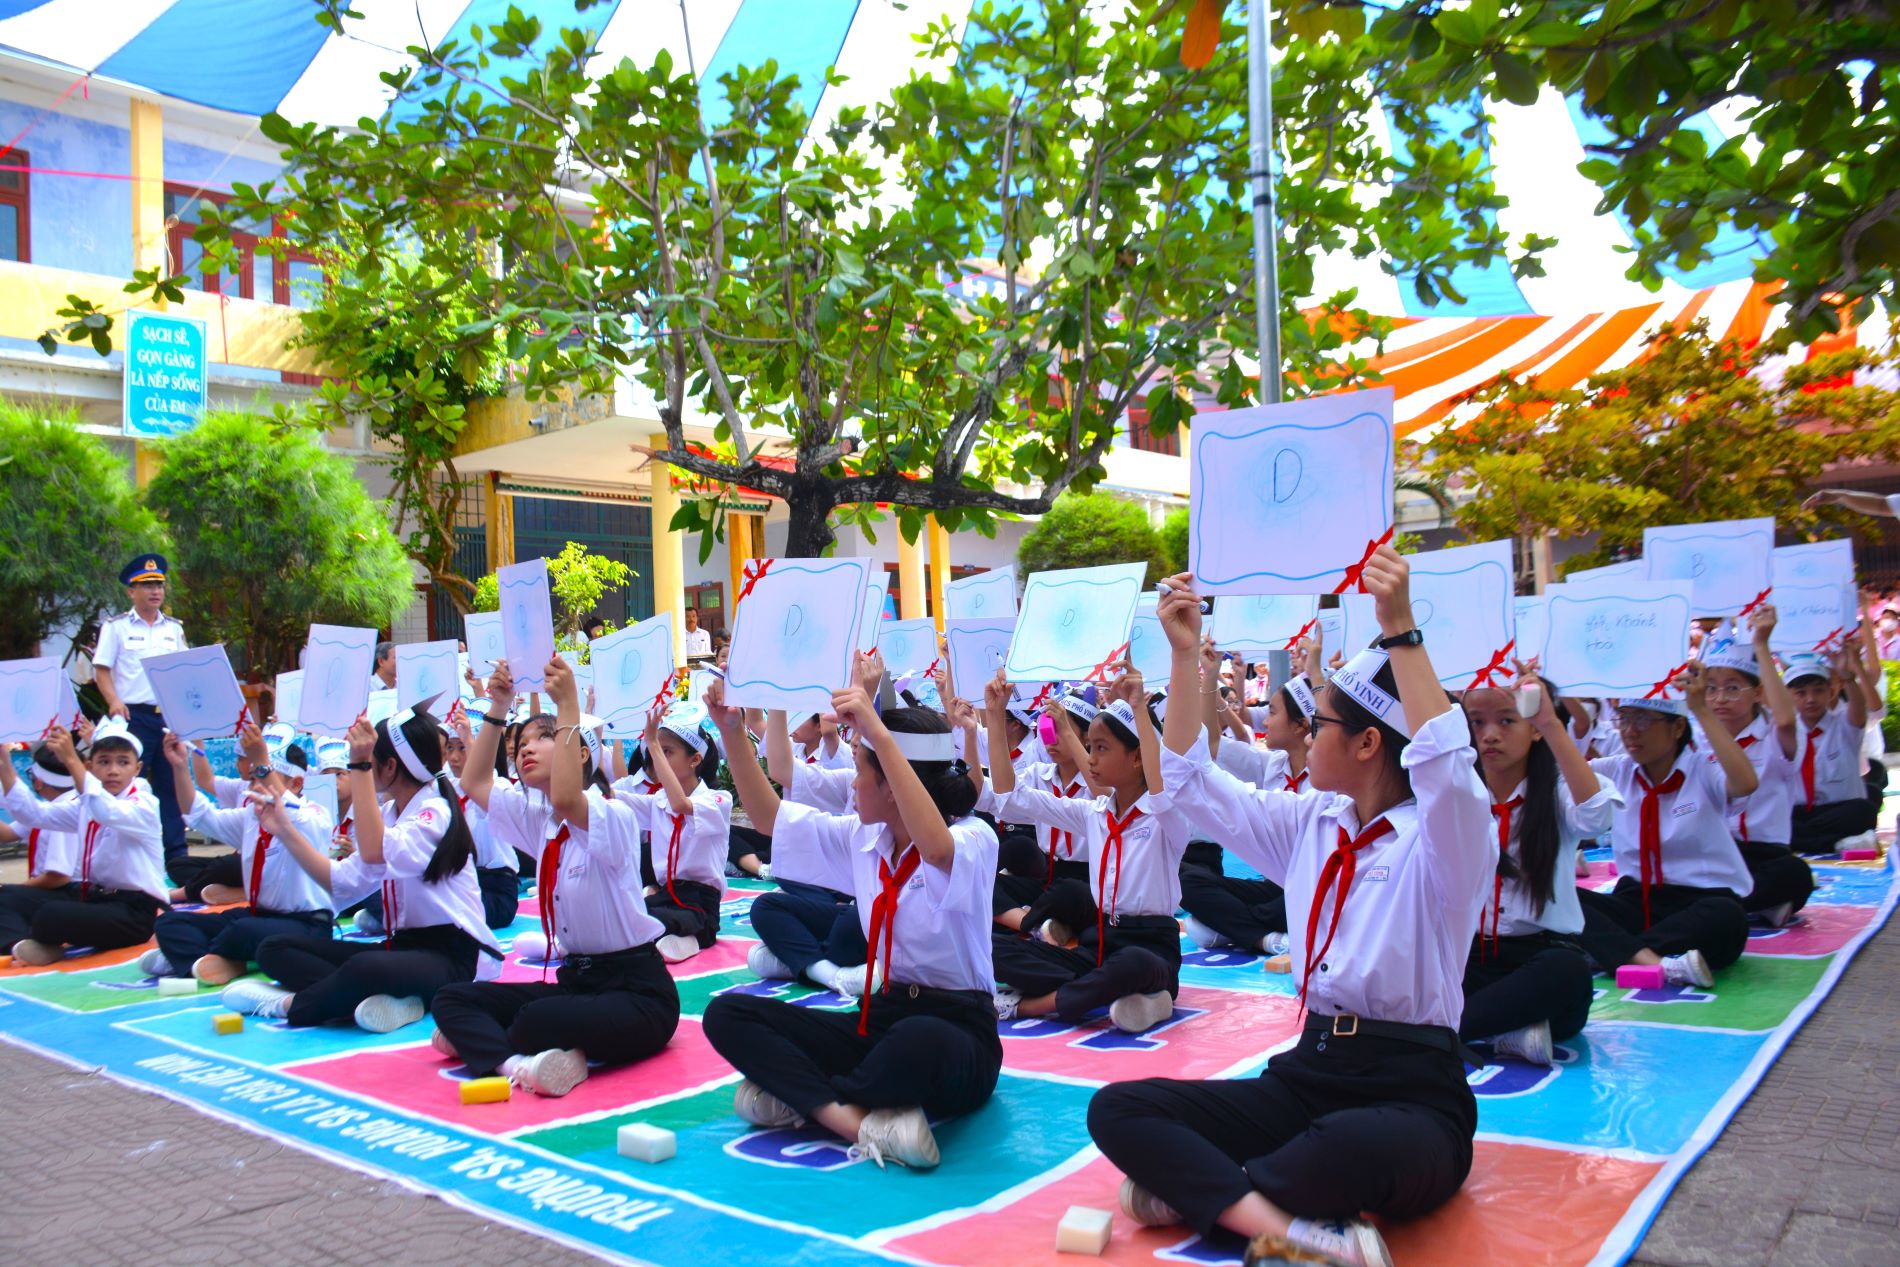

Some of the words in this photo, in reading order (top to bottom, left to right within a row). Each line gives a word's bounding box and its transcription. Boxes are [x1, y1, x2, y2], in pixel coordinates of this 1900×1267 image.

[142, 326, 173, 344] SẠCH
[137, 348, 162, 367] GỌN
[163, 348, 195, 369] GÀNG
[131, 368, 145, 387] LÀ
[147, 369, 170, 389] NẾP
[171, 371, 201, 393] SỐNG
[145, 393, 168, 413] CỦA
[170, 399, 187, 414] EM
[1273, 448, 1303, 503] D
[1691, 552, 1706, 578] B
[784, 604, 803, 636] D
[1062, 608, 1076, 627] D
[326, 657, 344, 698] D
[621, 649, 642, 685] D
[1354, 681, 1385, 710] VINH
[1118, 708, 1135, 724] VINH
[685, 733, 700, 746] VINH
[133, 1053, 214, 1076] NAM
[178, 1065, 254, 1088] VIỆT
[261, 1093, 336, 1117] LÀ
[302, 1104, 371, 1129] SA
[339, 1117, 472, 1161] HOÀNG
[448, 1146, 526, 1180] SA,
[496, 1166, 674, 1233] TRƯỜNG
